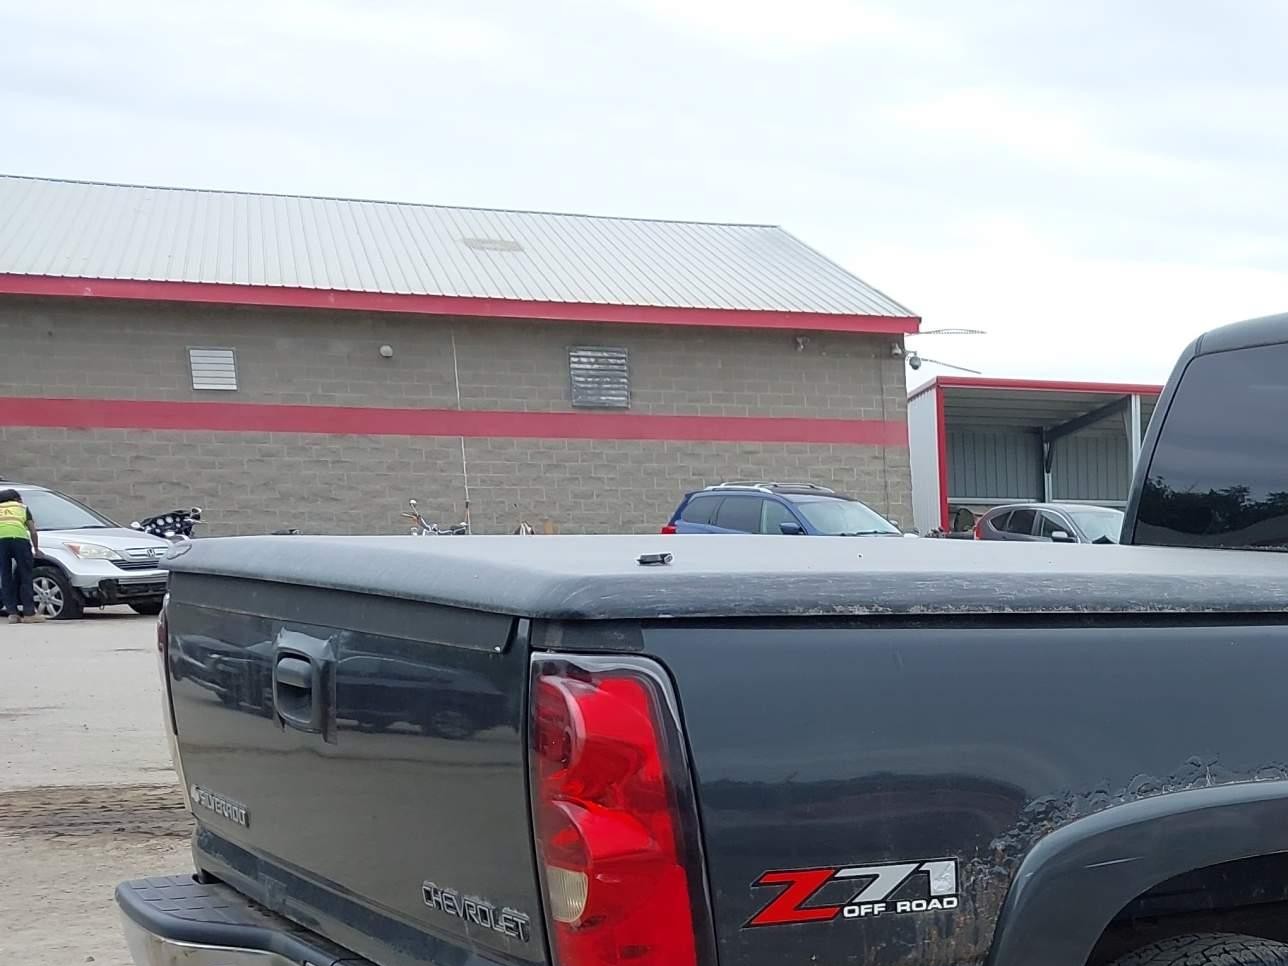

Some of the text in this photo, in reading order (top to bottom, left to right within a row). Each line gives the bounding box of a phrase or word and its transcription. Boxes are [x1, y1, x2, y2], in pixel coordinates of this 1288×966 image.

[421, 884, 529, 942] CHEVROLET
[742, 860, 959, 928] Z71
[843, 897, 958, 918] OFF ROAD
